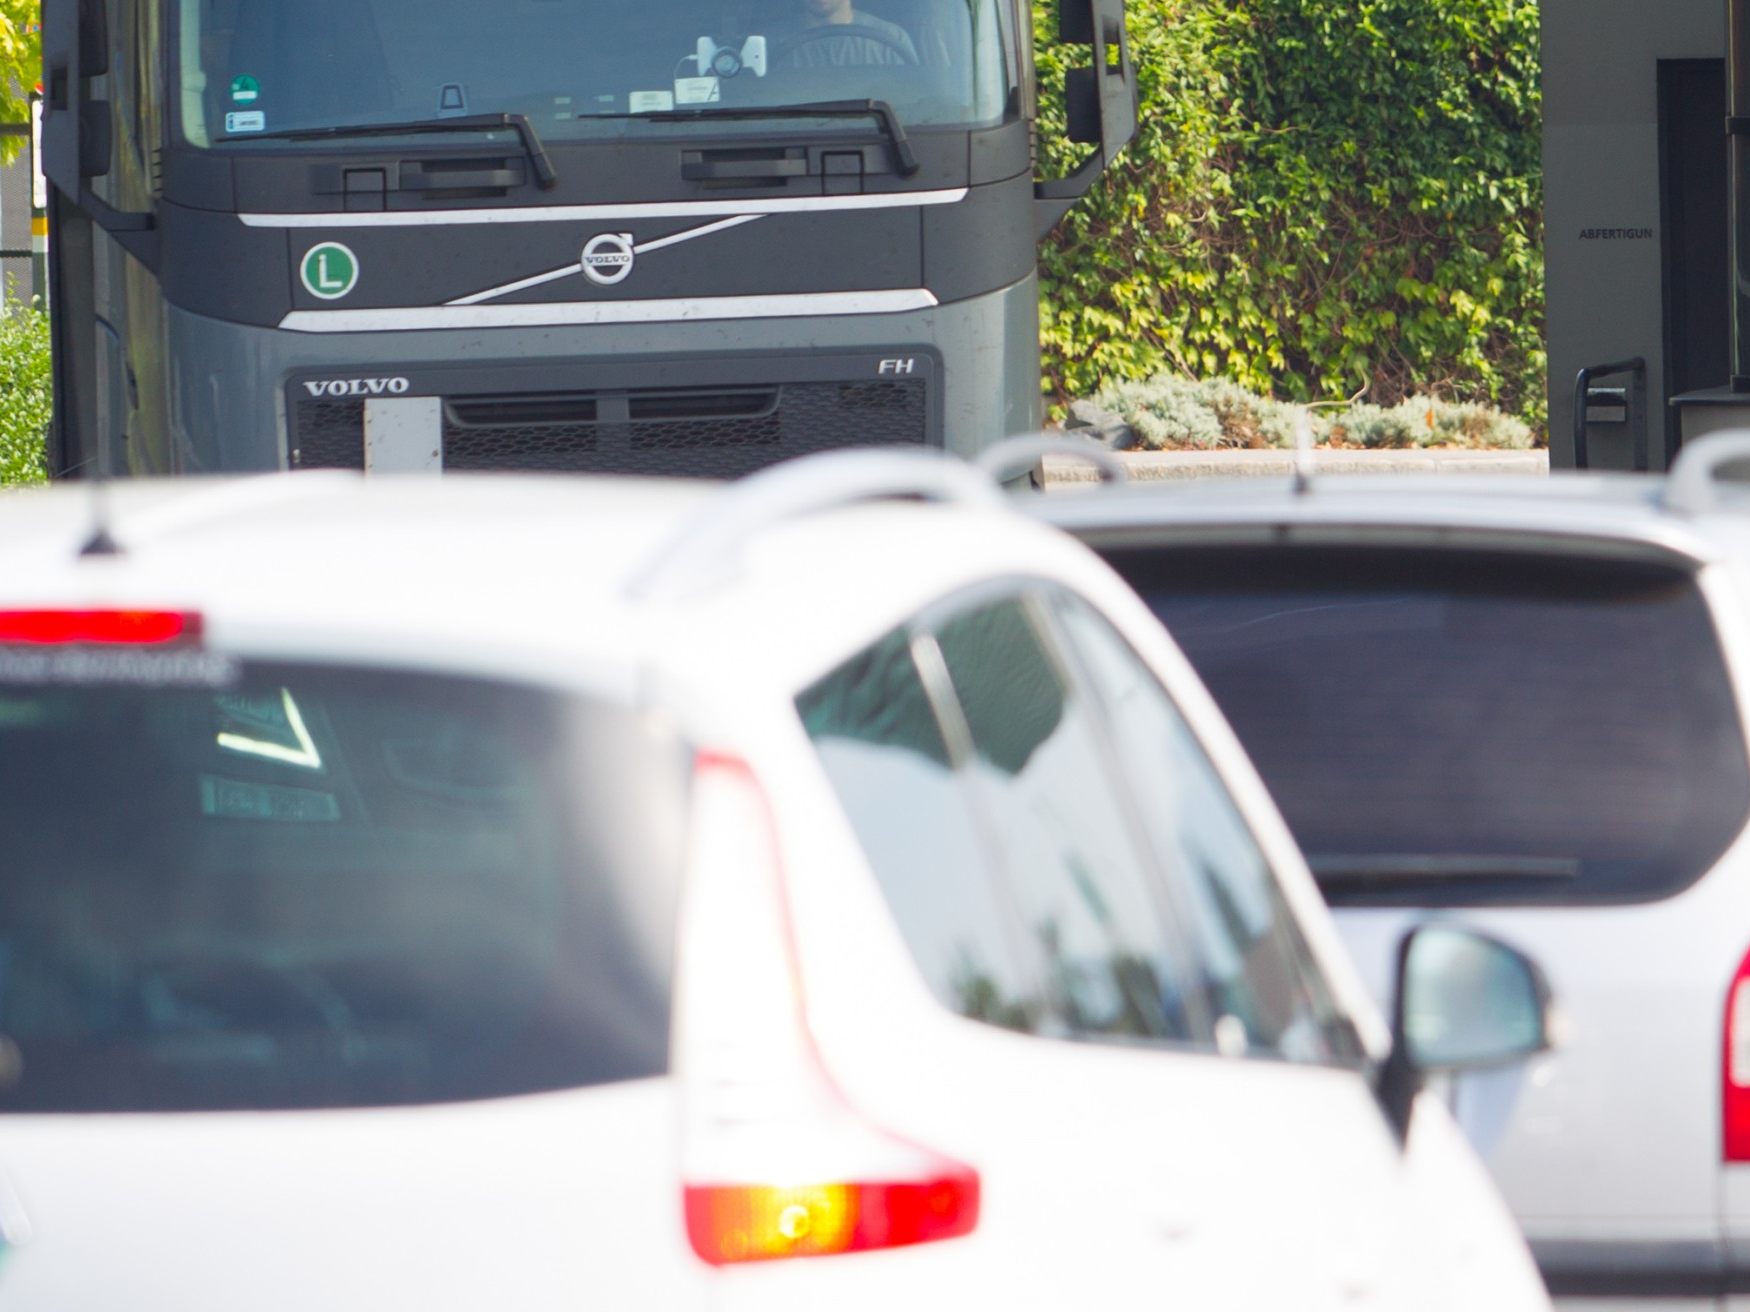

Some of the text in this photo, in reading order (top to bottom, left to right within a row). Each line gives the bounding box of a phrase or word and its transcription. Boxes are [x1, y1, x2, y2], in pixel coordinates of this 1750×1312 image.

[586, 255, 630, 264] VOLVO
[319, 254, 343, 288] L
[878, 358, 914, 374] FH
[303, 377, 409, 396] VOLVO
